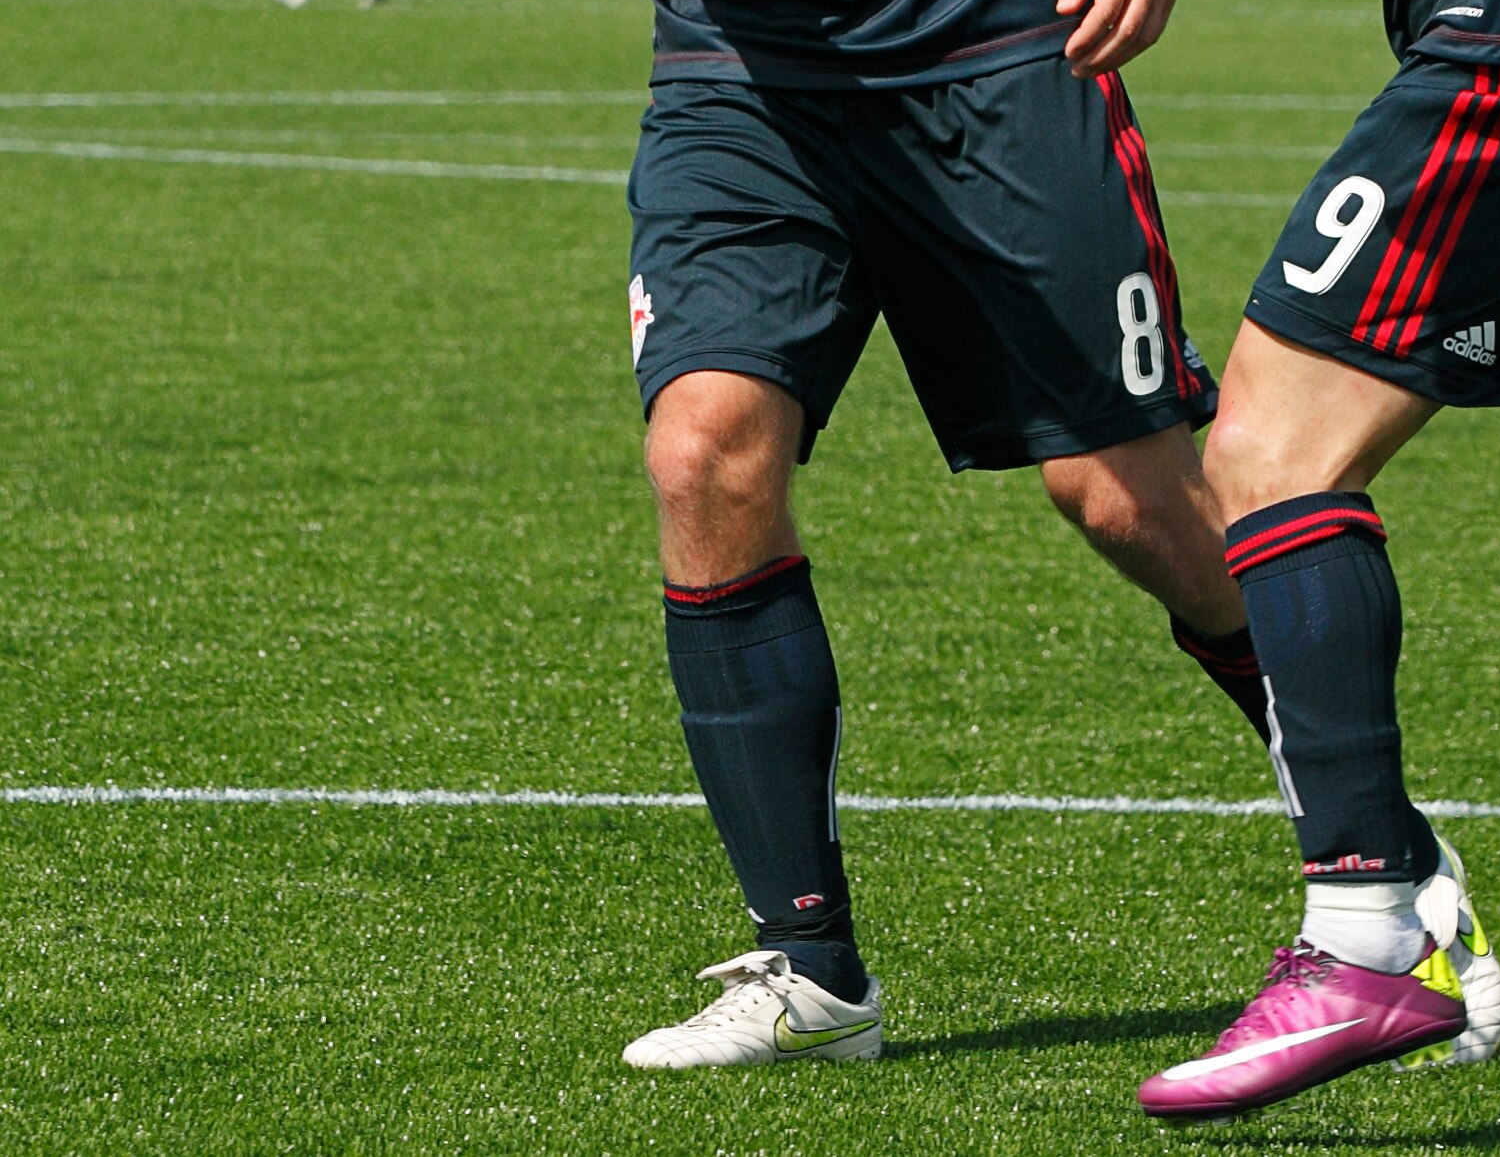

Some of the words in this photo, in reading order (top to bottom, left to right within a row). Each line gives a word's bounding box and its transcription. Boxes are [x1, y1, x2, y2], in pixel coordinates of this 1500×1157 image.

[1283, 175, 1386, 296] 9
[1115, 271, 1165, 396] 8
[1442, 336, 1497, 366] adidas
